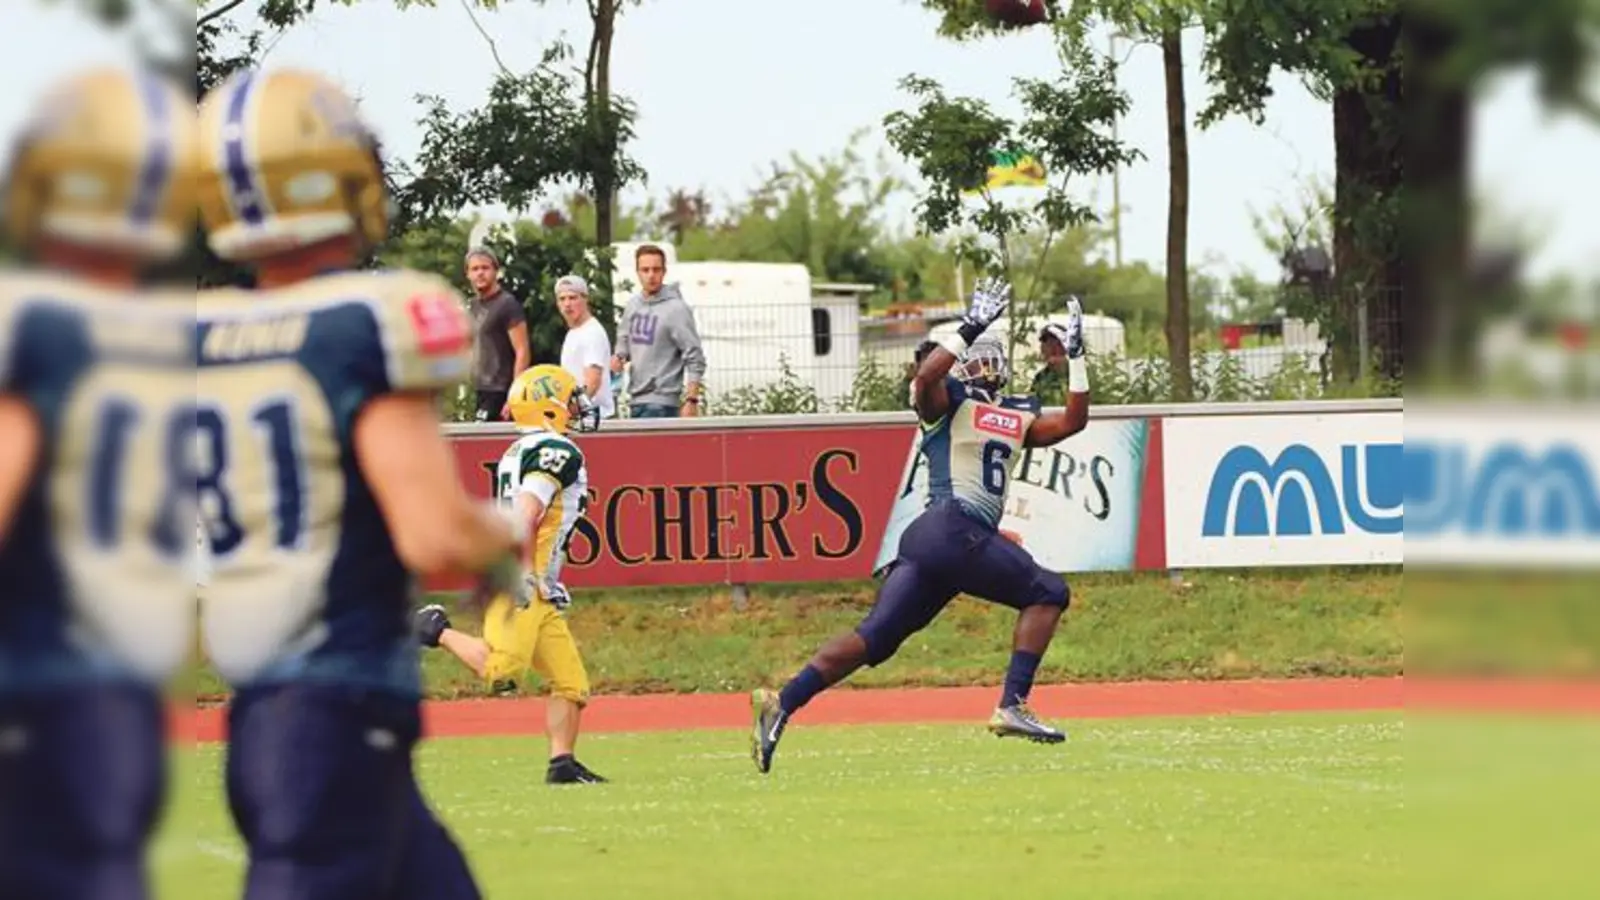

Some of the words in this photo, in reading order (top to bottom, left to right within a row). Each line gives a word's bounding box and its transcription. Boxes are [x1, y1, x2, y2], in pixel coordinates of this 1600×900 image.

[539, 446, 571, 473] 25
[983, 440, 1011, 496] 6
[483, 449, 863, 566] SCHER'S
